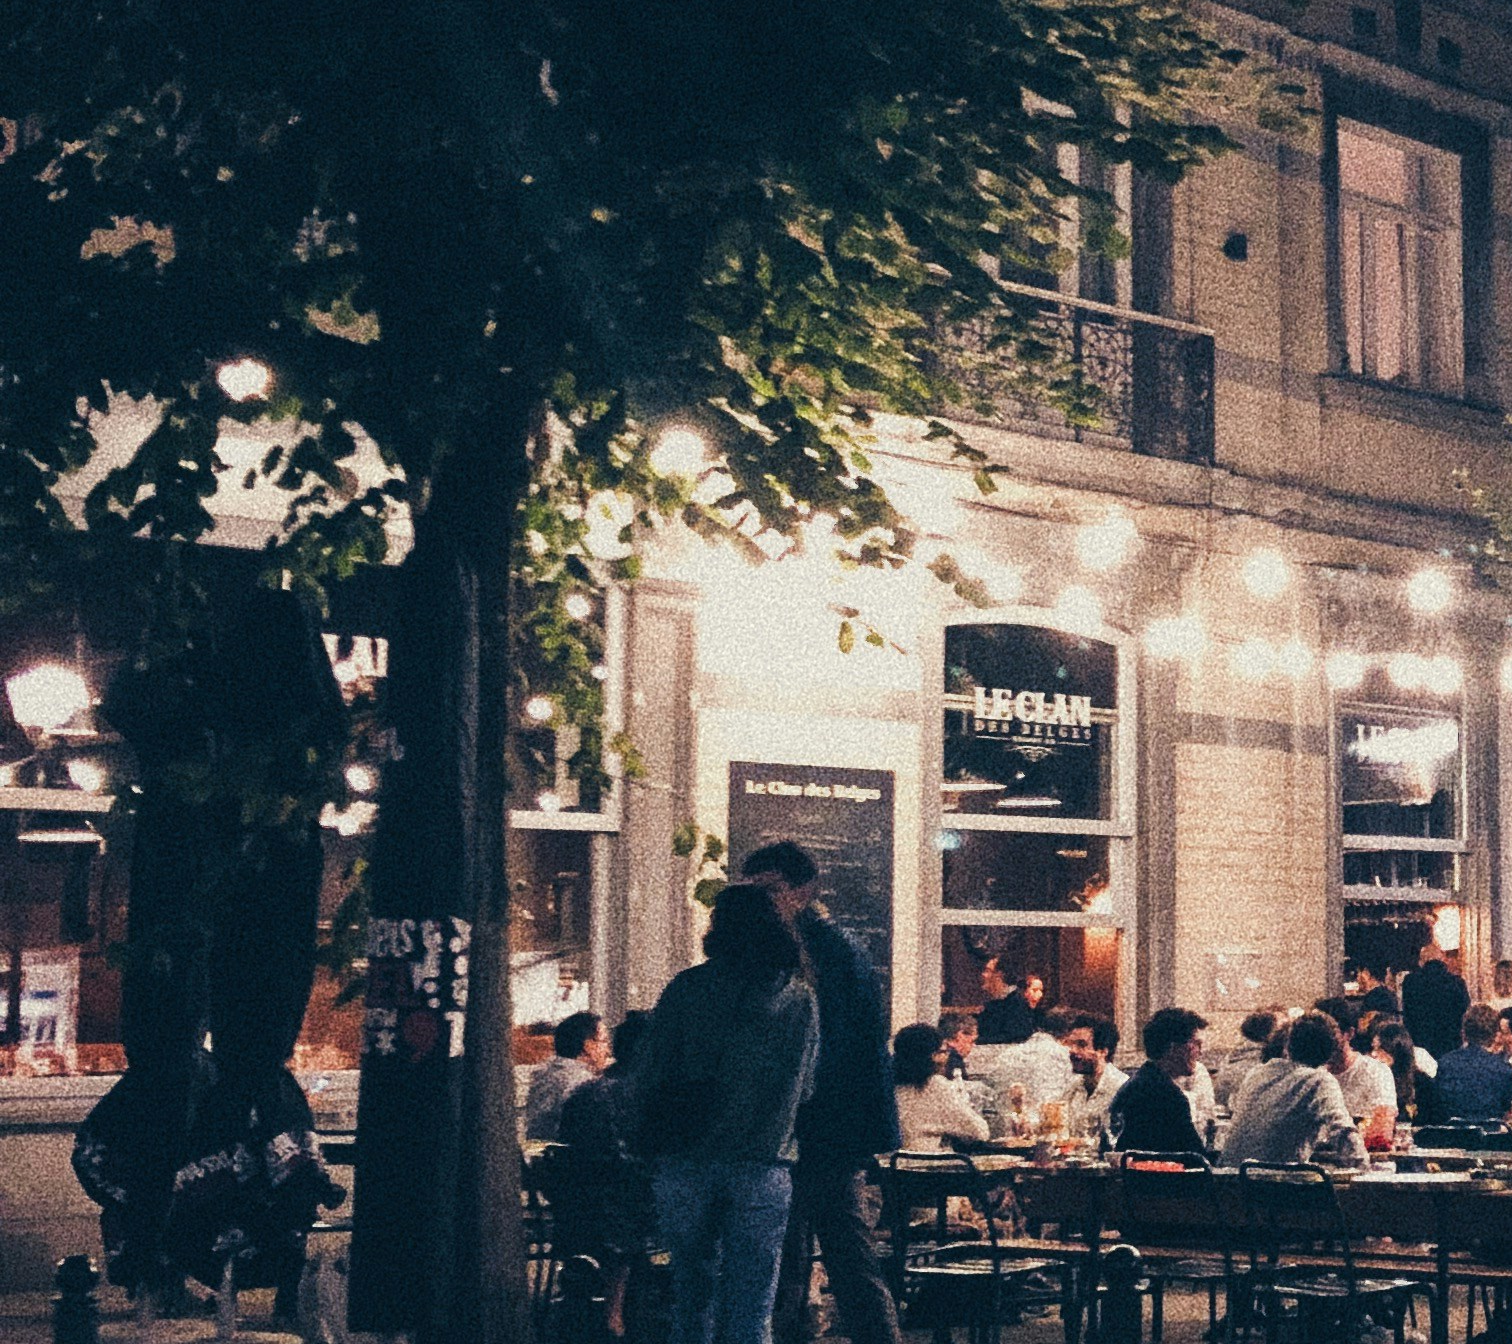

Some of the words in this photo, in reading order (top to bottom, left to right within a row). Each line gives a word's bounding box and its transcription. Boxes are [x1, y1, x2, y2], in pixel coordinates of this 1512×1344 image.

[973, 686, 1013, 720] LE
[1014, 690, 1092, 728] CLAN
[1021, 722, 1092, 740] BELGES
[745, 779, 766, 794] Le
[803, 782, 832, 799] des
